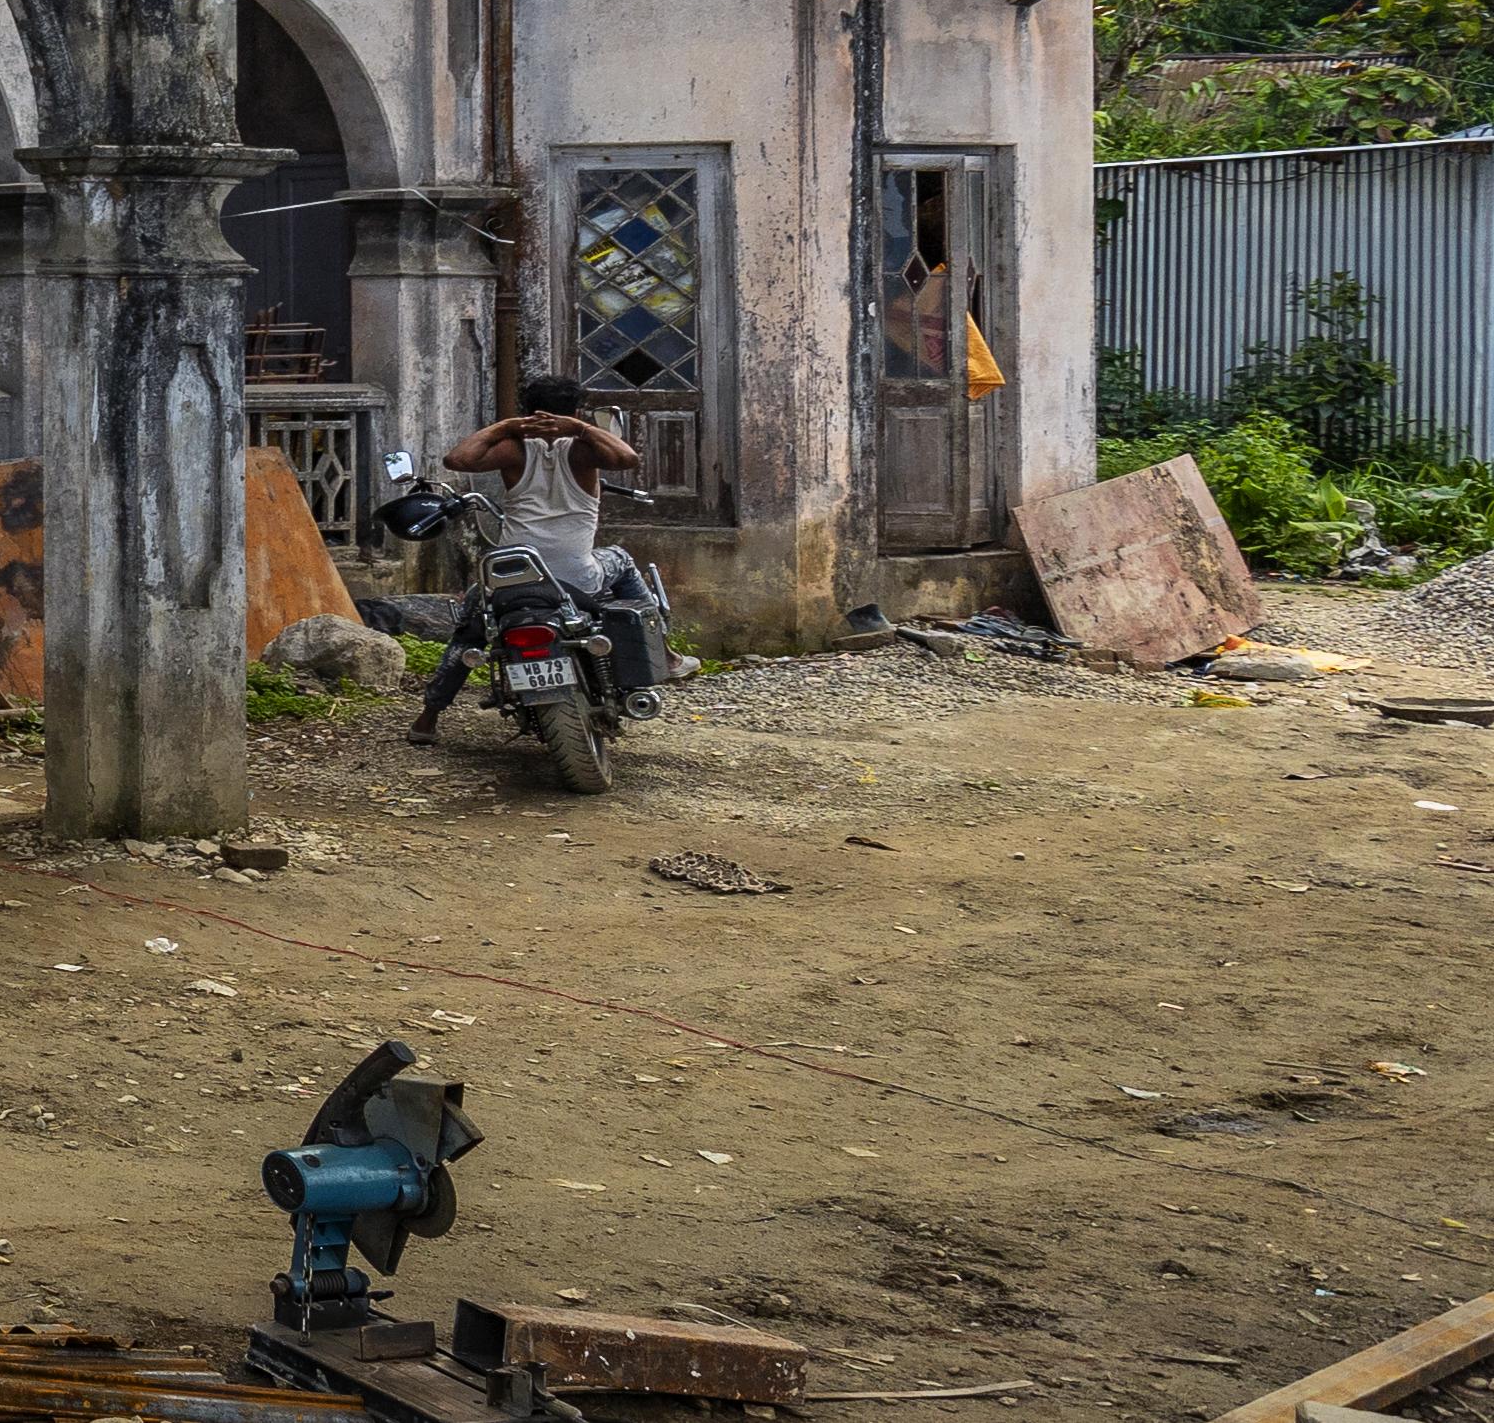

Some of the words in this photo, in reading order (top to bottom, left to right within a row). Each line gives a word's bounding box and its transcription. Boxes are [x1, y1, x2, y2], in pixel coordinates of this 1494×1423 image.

[523, 663, 541, 675] WB
[545, 661, 563, 673] 79
[529, 673, 564, 687] 6840
